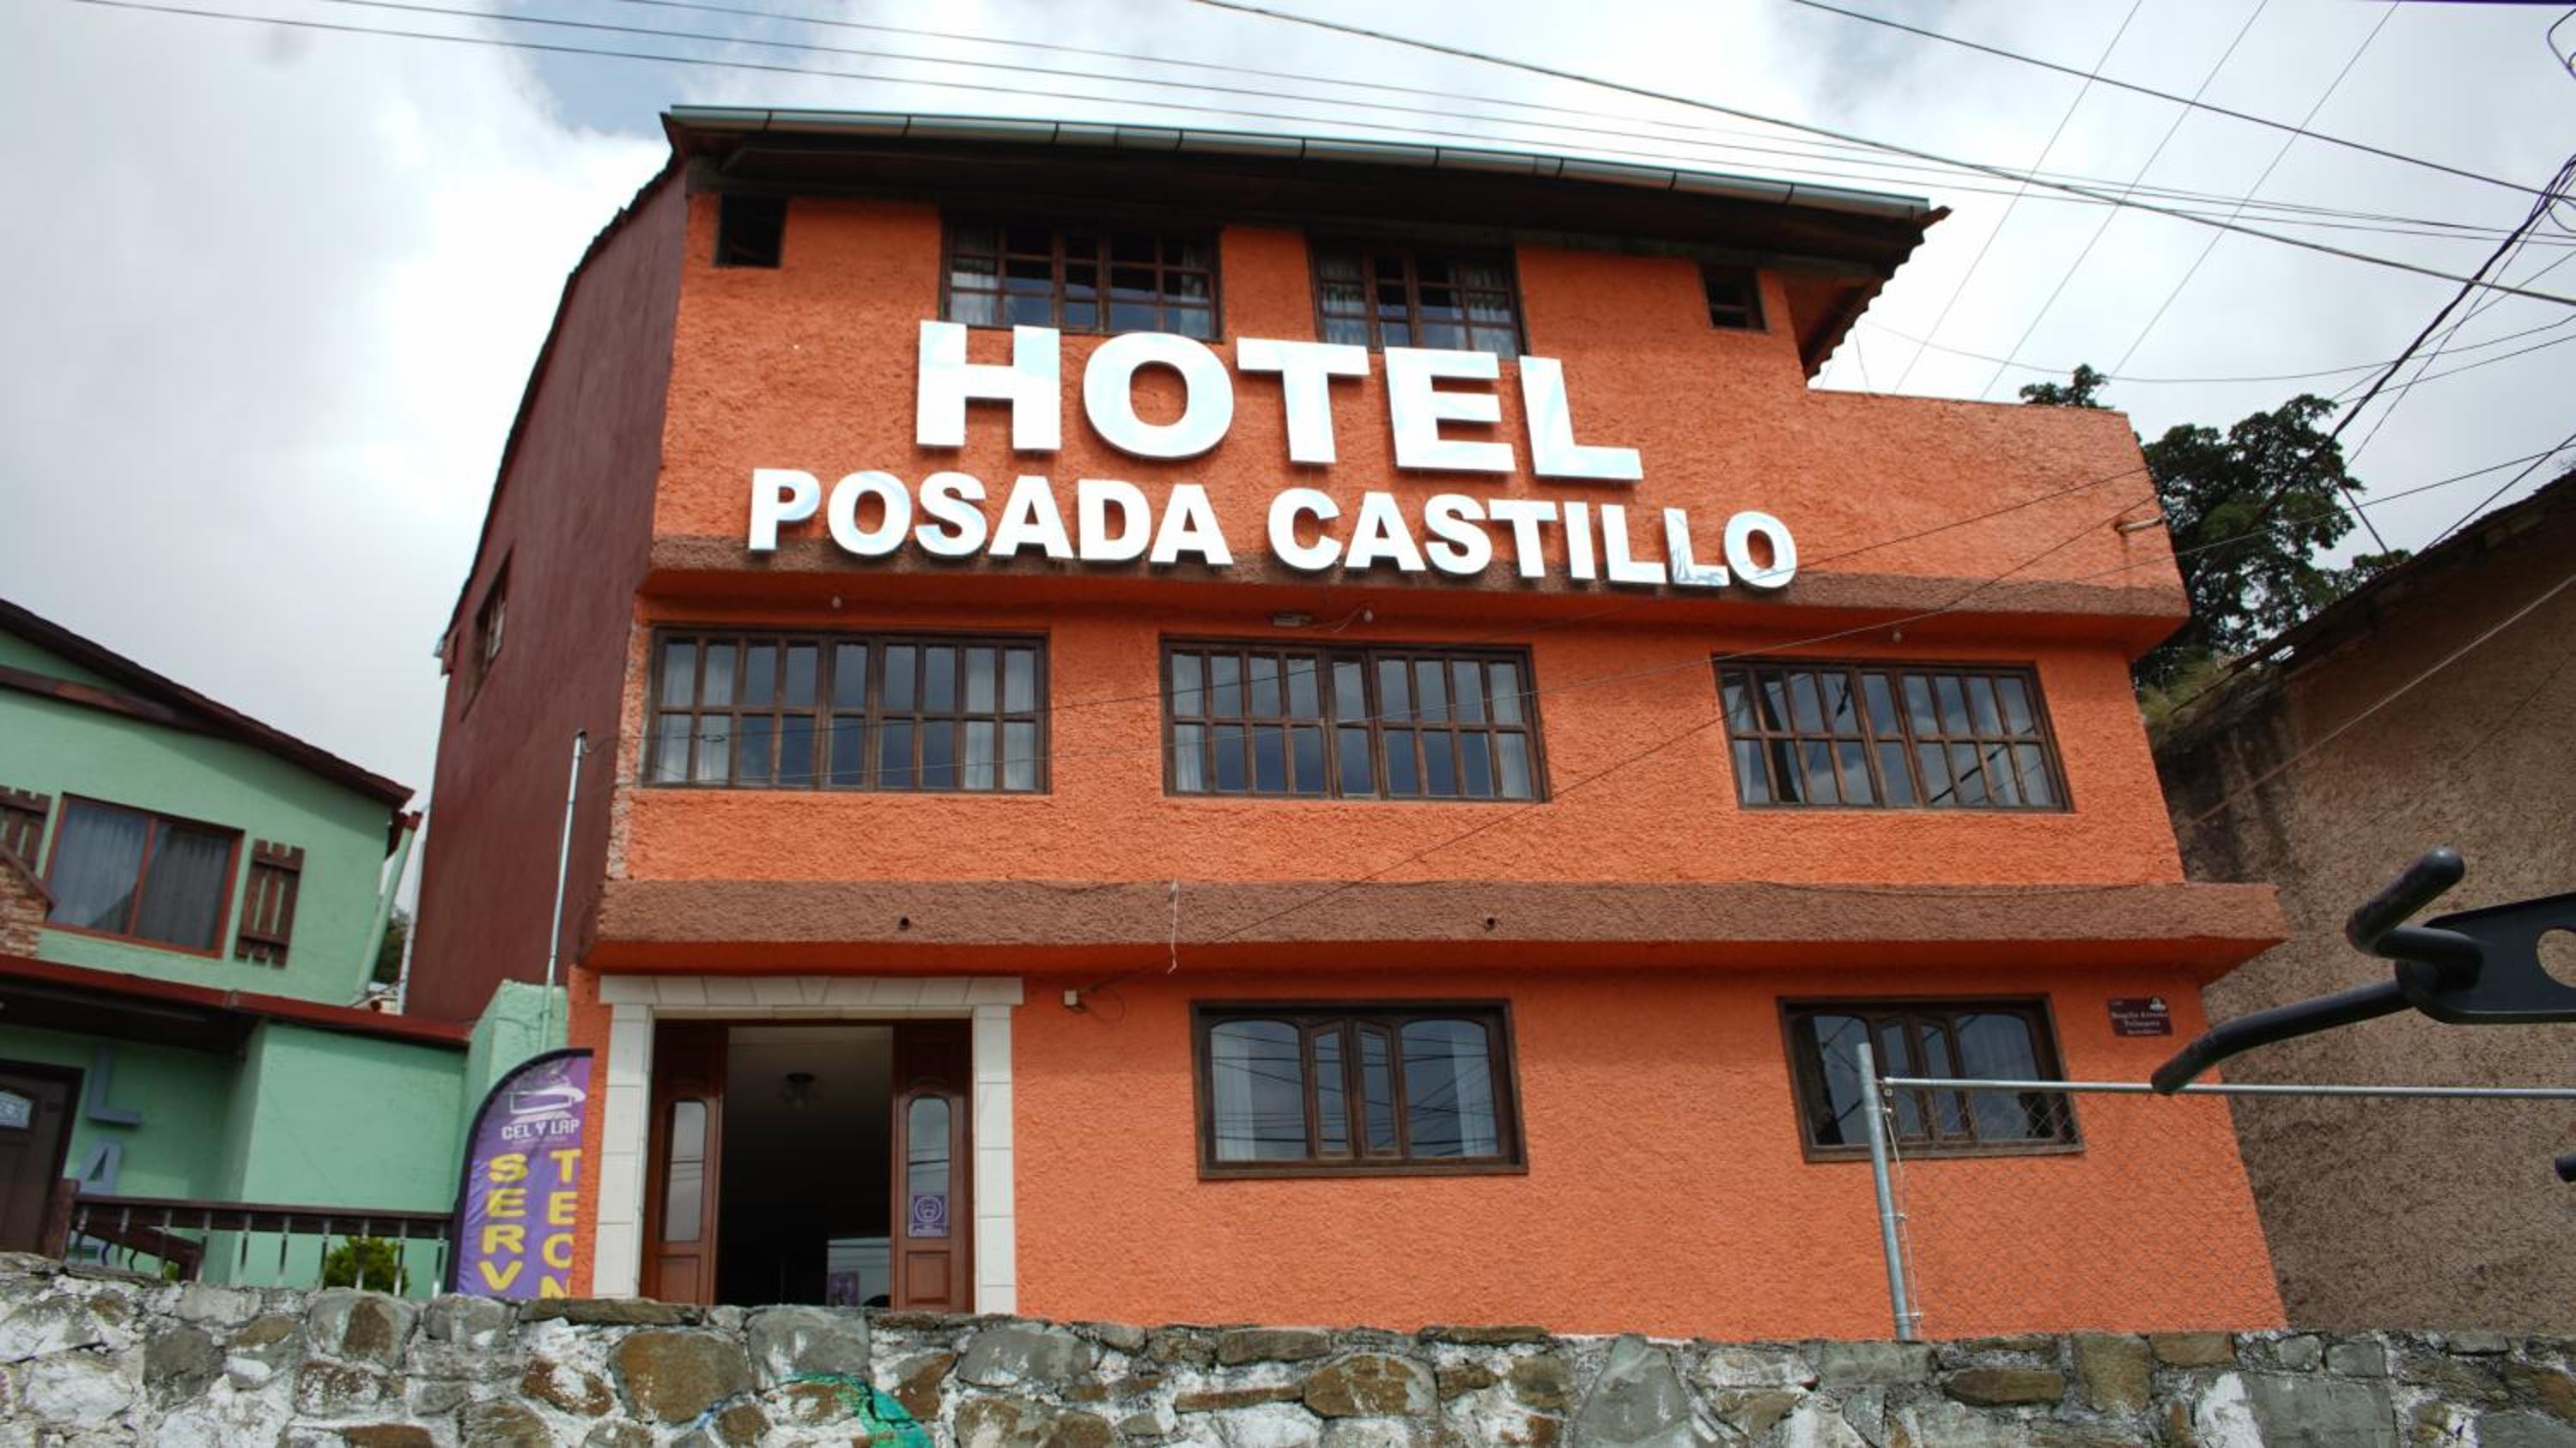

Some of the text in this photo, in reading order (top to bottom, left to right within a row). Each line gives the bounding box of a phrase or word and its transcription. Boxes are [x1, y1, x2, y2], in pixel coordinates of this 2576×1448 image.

[916, 319, 1643, 480] HOTEL
[749, 468, 1797, 590] POSADA CASTILLO
[502, 1125, 532, 1140] CEL
[536, 1123, 547, 1136] Y
[551, 1119, 580, 1135] LAP
